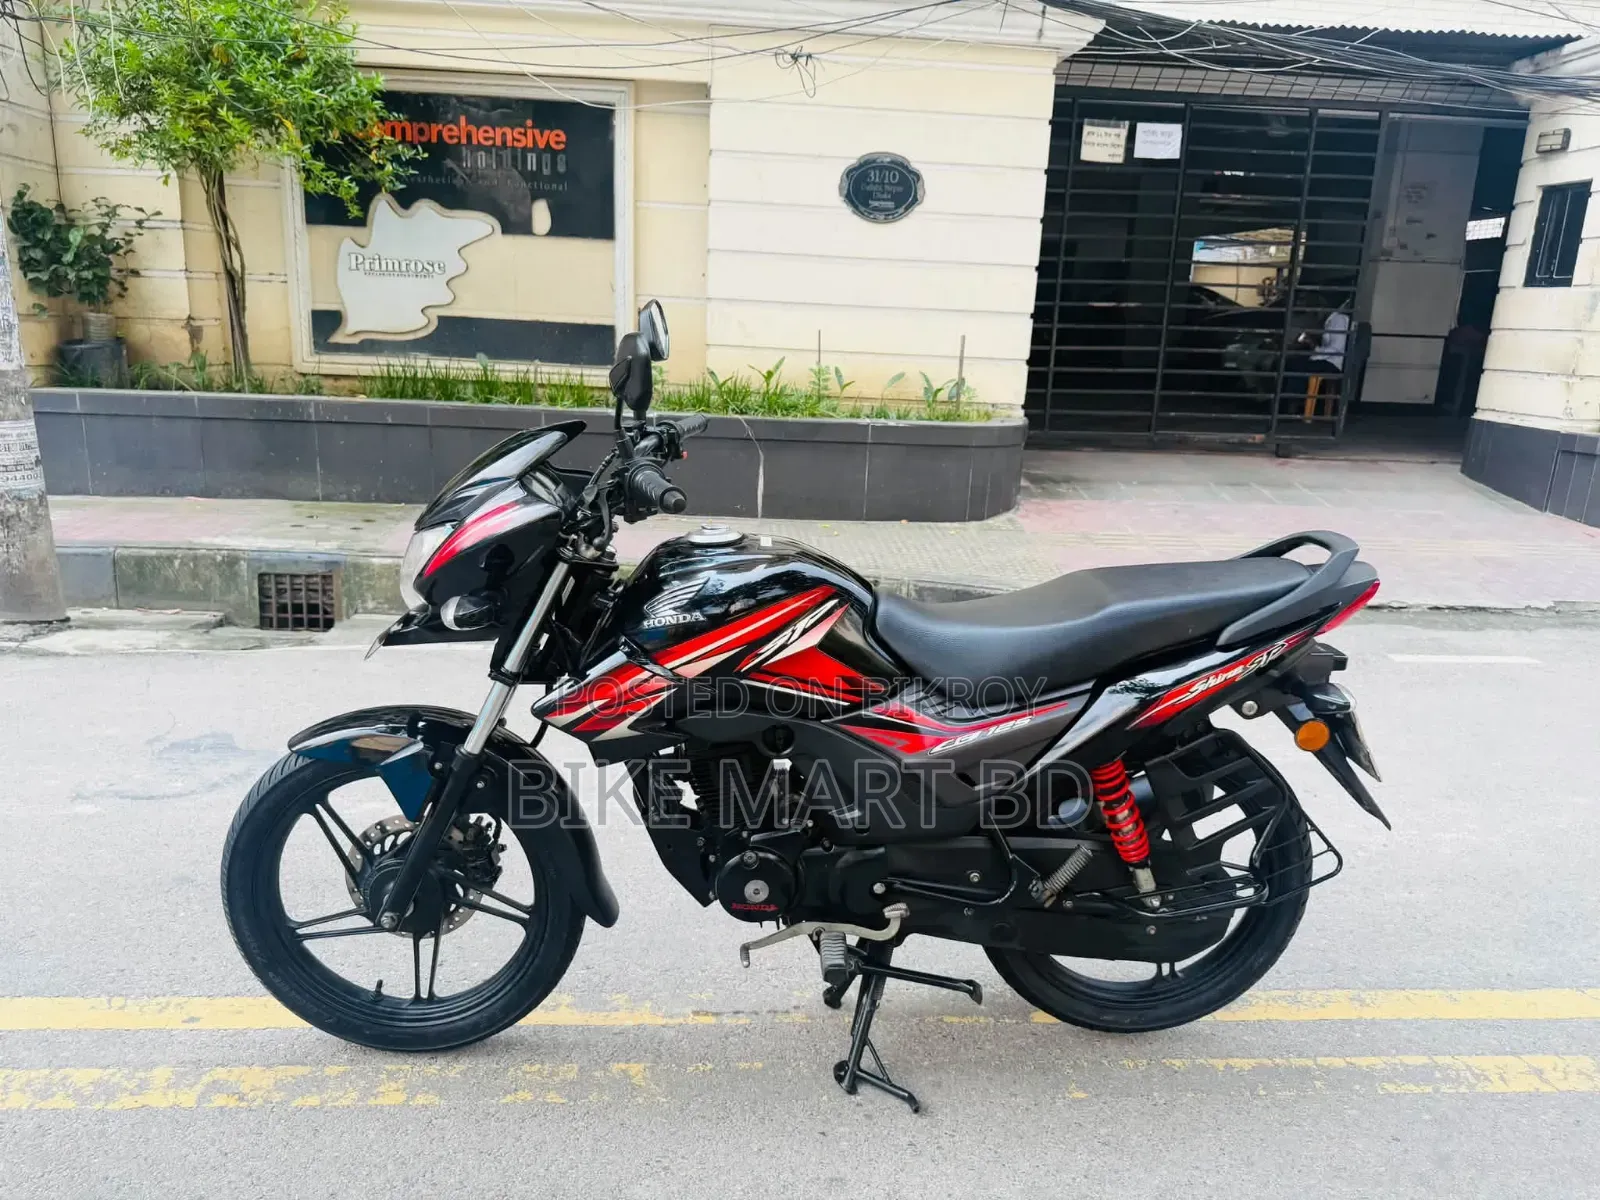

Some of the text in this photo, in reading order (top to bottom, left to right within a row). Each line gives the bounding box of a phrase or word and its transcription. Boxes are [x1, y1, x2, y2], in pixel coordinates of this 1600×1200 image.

[357, 114, 567, 150] mprehensive
[867, 170, 899, 183] 31/10
[348, 252, 446, 275] Primrose
[643, 612, 707, 629] HONDA
[1182, 665, 1243, 701] Shine
